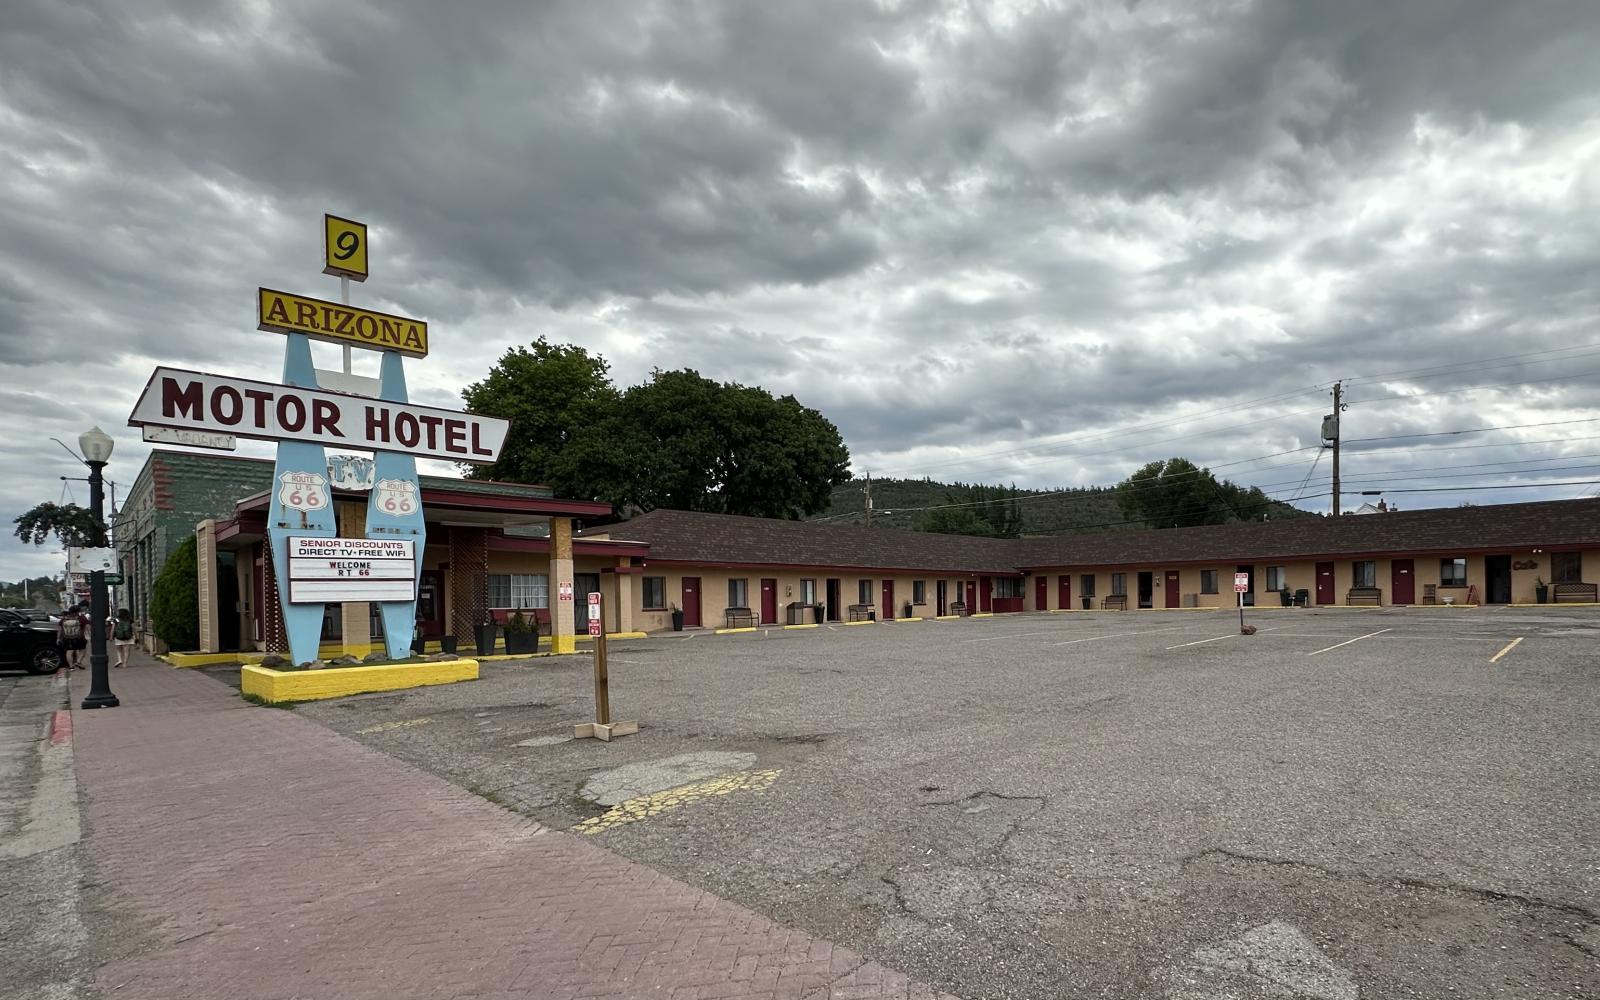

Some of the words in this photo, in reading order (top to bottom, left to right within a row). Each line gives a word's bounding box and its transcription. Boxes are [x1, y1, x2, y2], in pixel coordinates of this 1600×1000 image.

[334, 231, 359, 260] 9
[266, 297, 424, 349] ARIZONA
[162, 377, 345, 438] MOTOR
[365, 405, 493, 456] HOTEL
[330, 458, 374, 483] TV
[292, 475, 315, 484] ROUTE
[387, 483, 407, 491] ROUTE
[290, 491, 319, 506] 66
[385, 497, 411, 512] 66
[299, 548, 338, 556] DIRECT
[359, 549, 383, 557] FREE
[345, 541, 404, 549] DISCOUNTS
